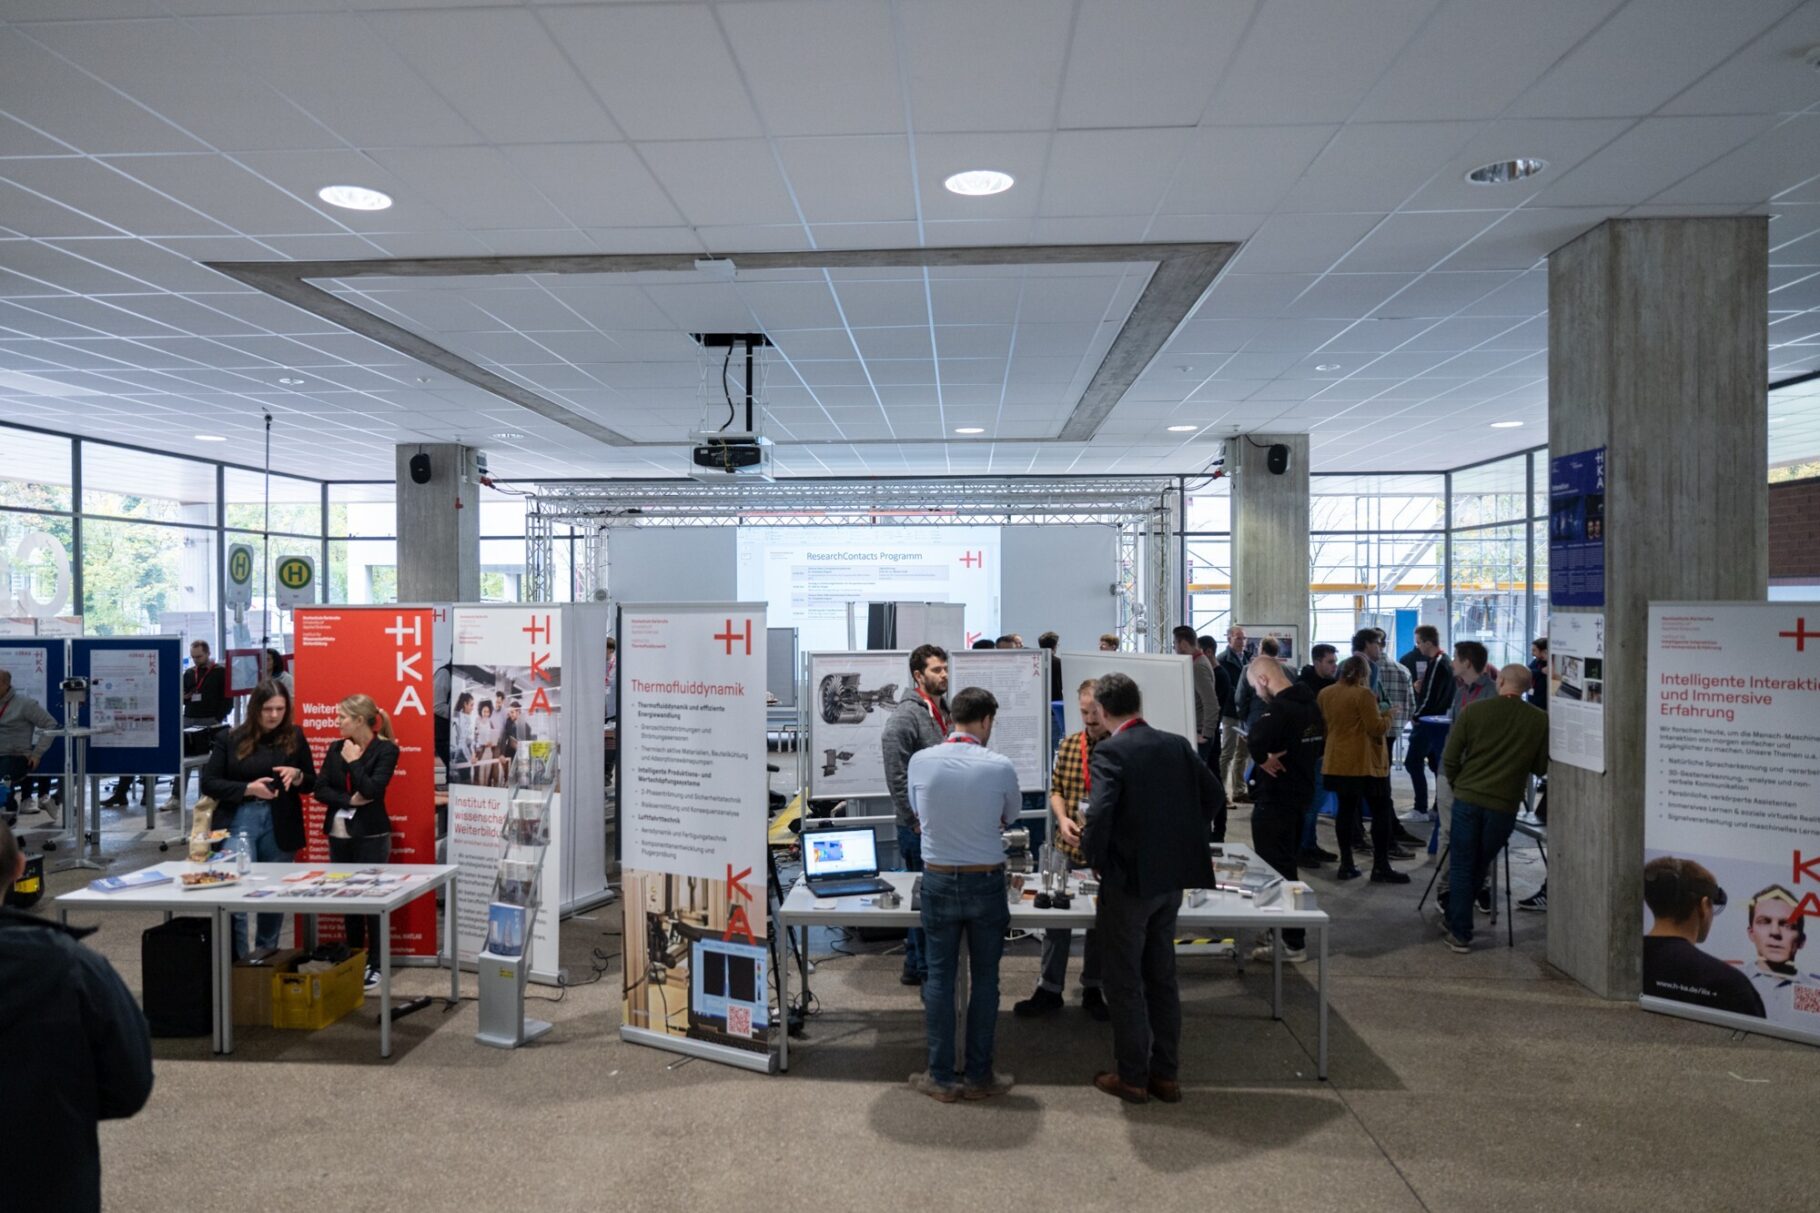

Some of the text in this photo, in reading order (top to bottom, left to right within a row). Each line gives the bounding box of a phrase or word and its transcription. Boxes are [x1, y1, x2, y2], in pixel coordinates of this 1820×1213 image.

[806, 552, 922, 562] ResearchContacts Programm
[288, 566, 302, 582] H
[632, 679, 744, 698] Thermofluiddynamik
[1661, 673, 1820, 691] Intelligente Interakti
[1661, 690, 1772, 705] und Immersive
[1660, 703, 1735, 722] Erfahrung
[1704, 728, 1725, 736] heute,
[1712, 738, 1739, 746] morgen
[1741, 739, 1775, 748] einfacher
[1774, 750, 1802, 758] Themen
[1668, 758, 1704, 766] Natürliche
[1668, 778, 1749, 791] verbale Kommunikation
[454, 797, 500, 810] Institut für
[1754, 798, 1797, 808] Assistenten
[1668, 802, 1707, 811] Immersives
[1741, 809, 1766, 817] soziale
[1768, 812, 1798, 820] virtuelle
[1668, 814, 1732, 827] Signalverarbeitung
[1750, 823, 1797, 834] maschinelles
